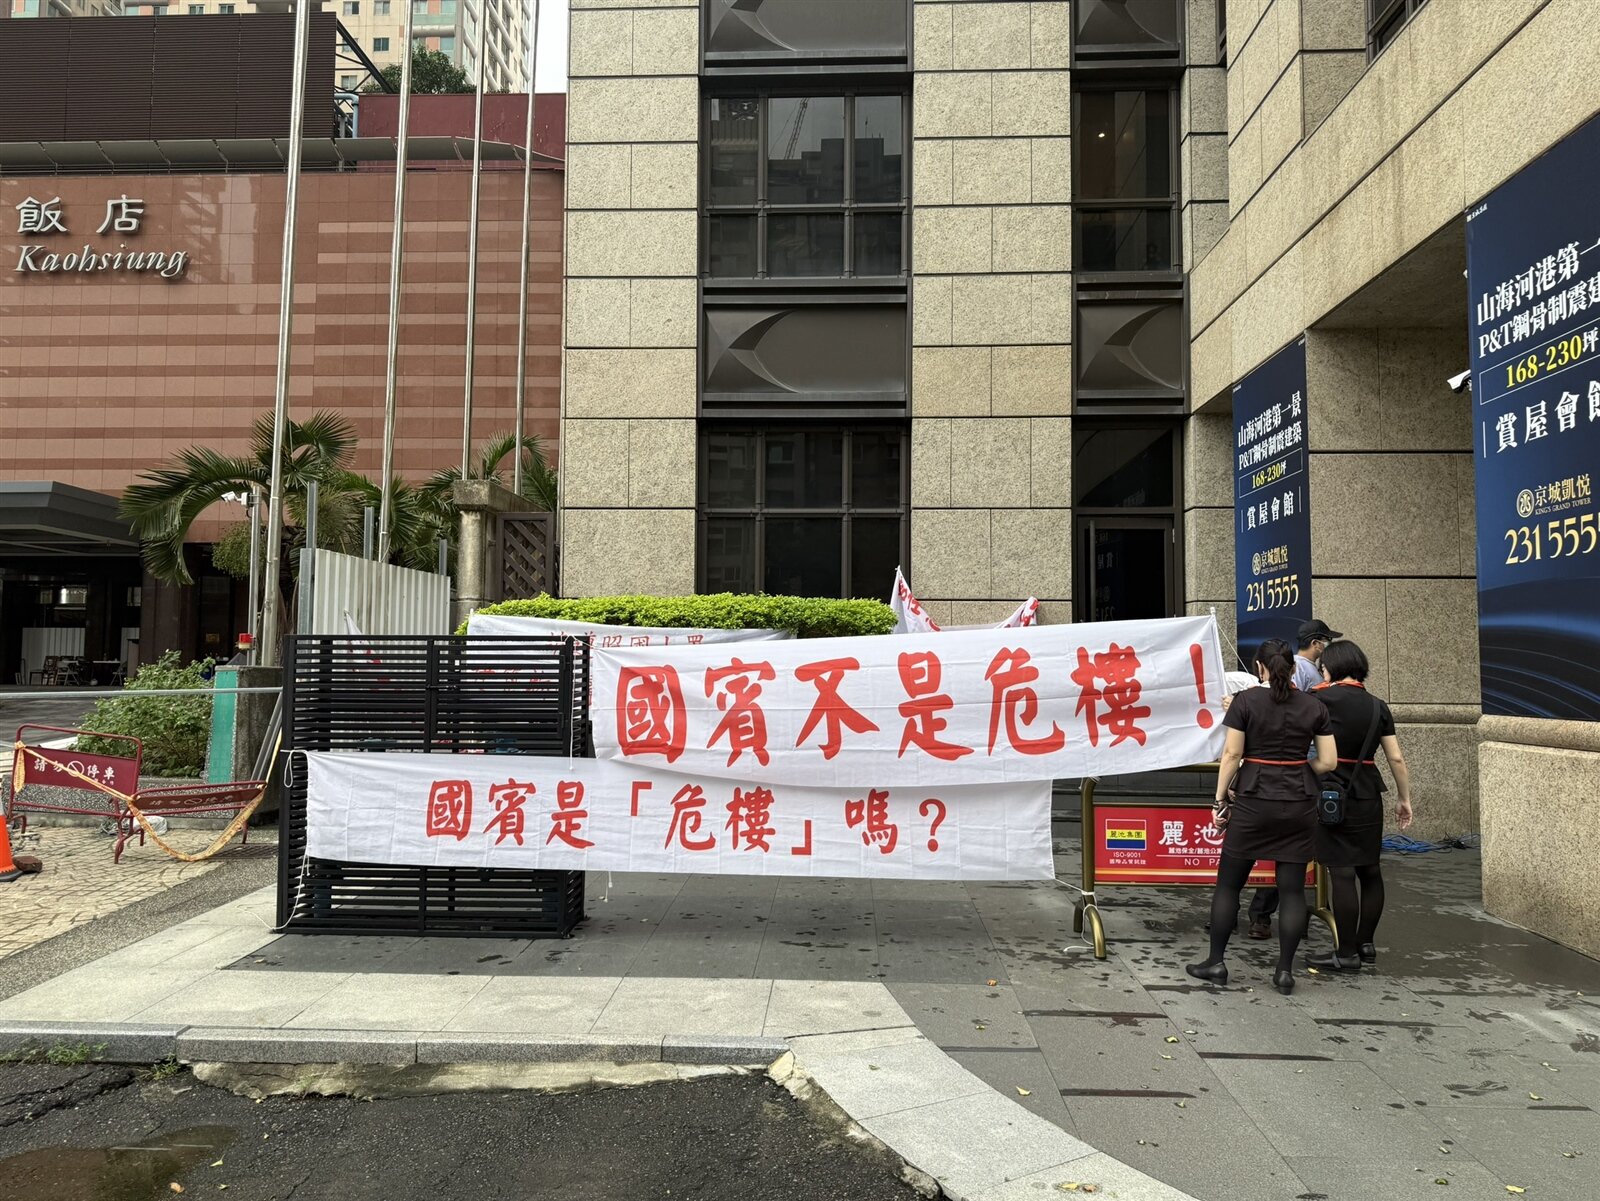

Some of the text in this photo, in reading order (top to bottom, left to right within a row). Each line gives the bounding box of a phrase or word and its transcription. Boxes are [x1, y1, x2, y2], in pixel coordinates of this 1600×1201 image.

[16, 194, 145, 234] 飯店
[15, 244, 189, 280] Kaohsiung
[1506, 327, 1600, 389] 168-230坪
[1238, 390, 1302, 448] 山海河港第一景
[1252, 460, 1287, 489] 168-230坪
[1247, 490, 1294, 531] 賞屋會館
[1552, 502, 1571, 512] GRAND
[1572, 497, 1592, 508] TOWER
[1504, 511, 1600, 565] 231 555
[1267, 574, 1299, 609] 5555
[616, 642, 1214, 767] 國賓不是危樓！
[427, 779, 946, 856] 國賓是「危樓」嗎？
[1109, 830, 1143, 838] 麗池集團
[1184, 858, 1200, 866] NO
